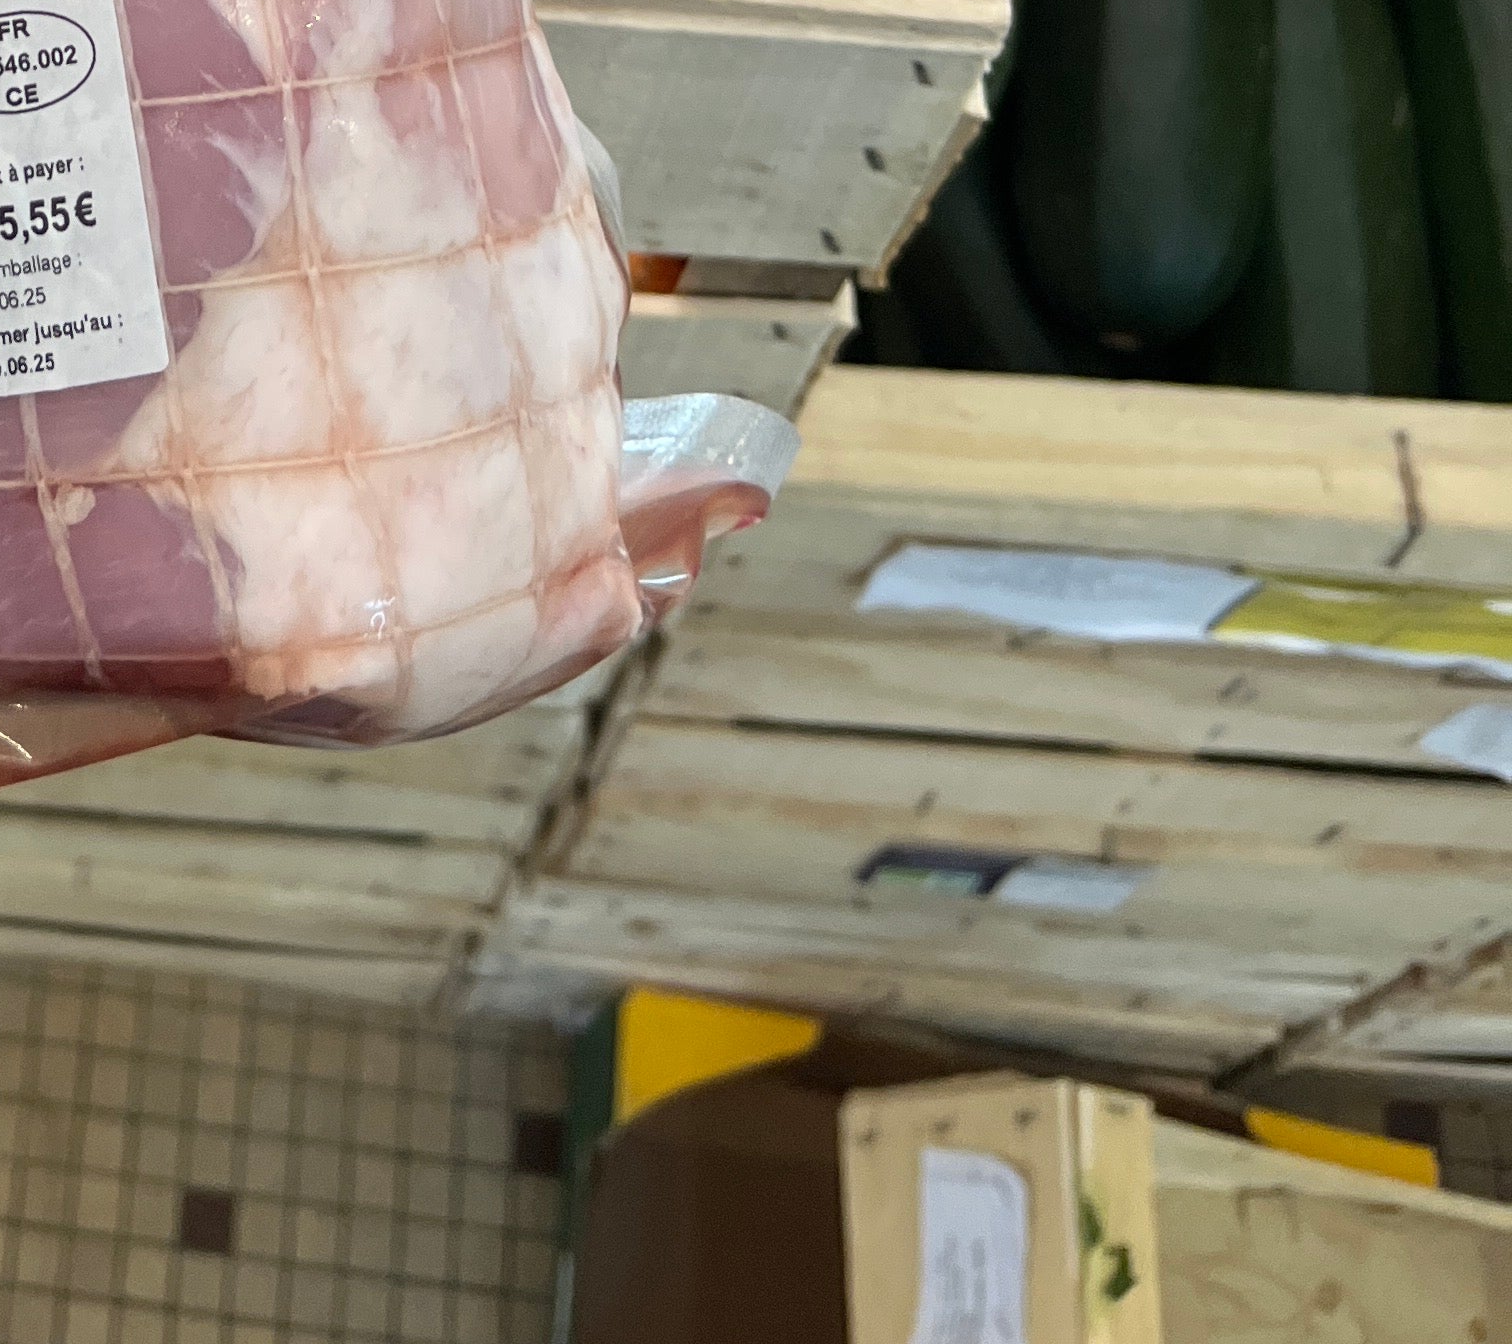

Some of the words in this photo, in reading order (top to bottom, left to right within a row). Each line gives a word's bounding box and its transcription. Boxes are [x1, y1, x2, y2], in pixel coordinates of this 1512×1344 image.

[5, 83, 39, 106] CE
[9, 163, 19, 182] à
[23, 157, 73, 184] payer
[34, 314, 113, 345] jusqu'au
